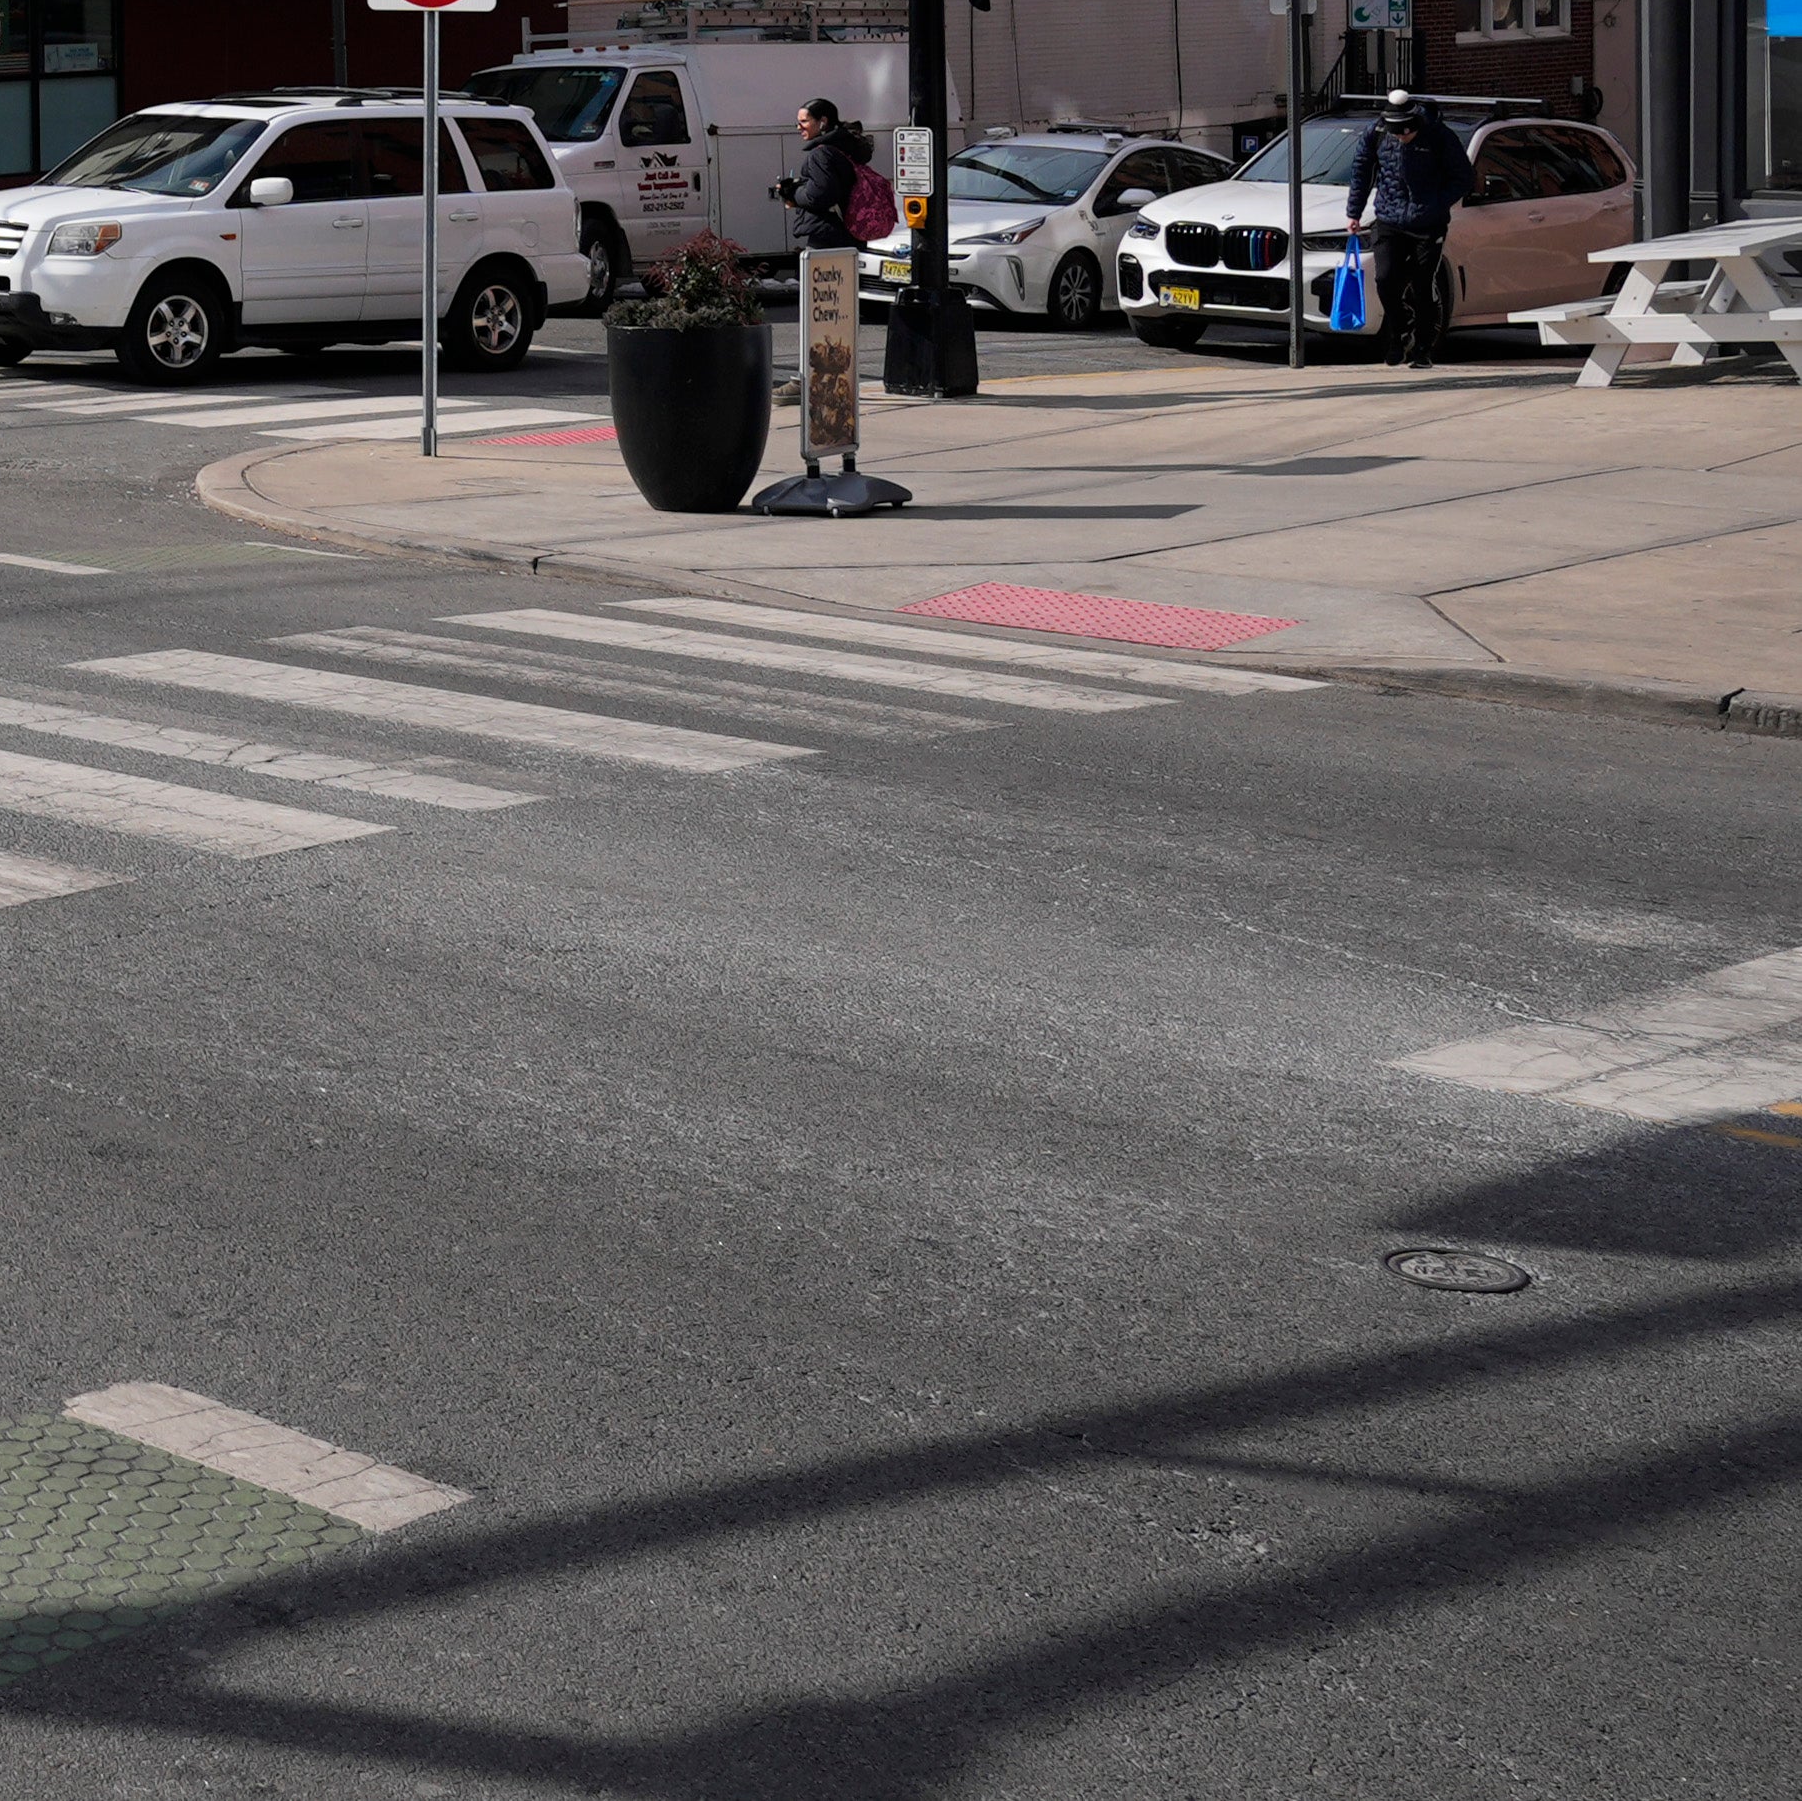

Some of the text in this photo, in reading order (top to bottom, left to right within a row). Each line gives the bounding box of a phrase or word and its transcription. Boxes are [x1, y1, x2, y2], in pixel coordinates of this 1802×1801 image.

[812, 265, 844, 286] Chunky,
[812, 287, 840, 307] Dunky,
[812, 307, 849, 326] Chewy...
